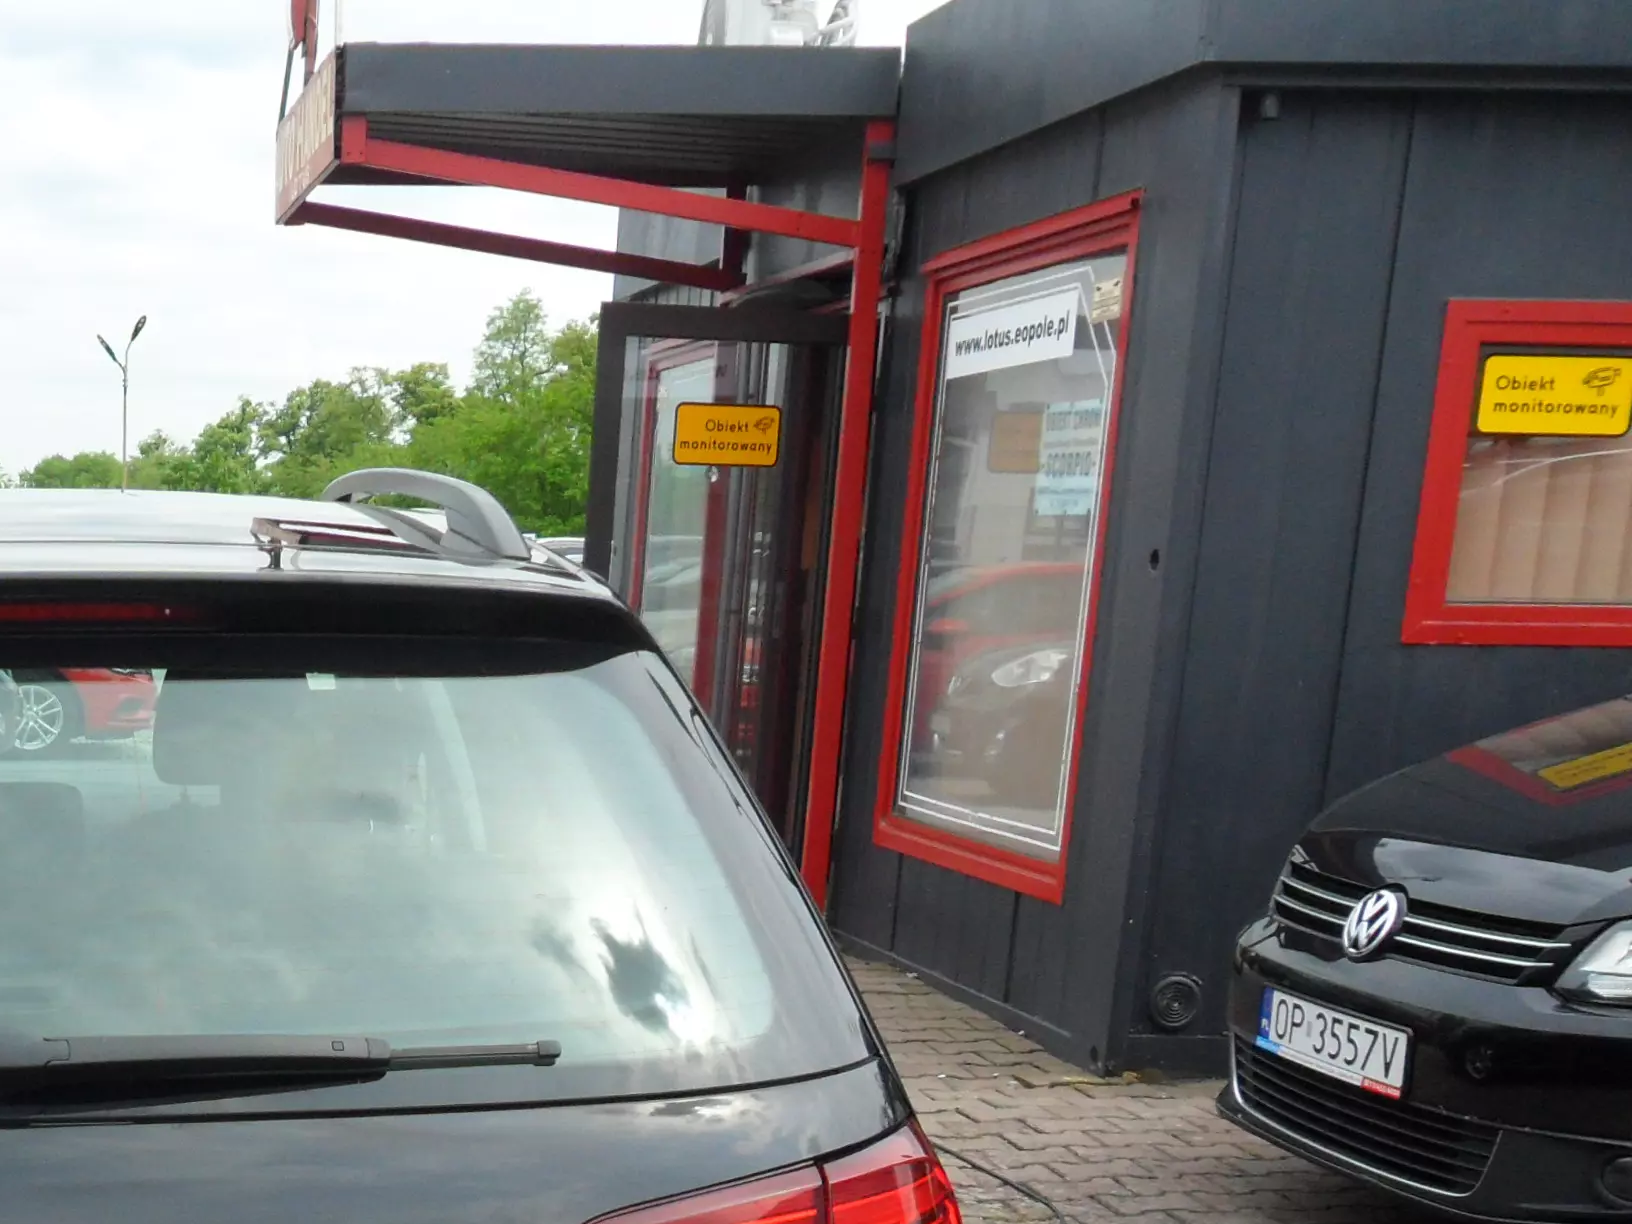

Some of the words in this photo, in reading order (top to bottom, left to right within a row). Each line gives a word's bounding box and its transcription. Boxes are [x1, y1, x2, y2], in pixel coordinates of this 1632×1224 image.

[955, 309, 1070, 356] www.lotus.eopole.pl
[1495, 374, 1556, 391] Obiekt
[1493, 399, 1619, 419] monitorowany
[705, 418, 749, 433] Obiekt
[679, 438, 773, 456] monitorowany
[1275, 999, 1305, 1044] OP
[1313, 1012, 1399, 1079] 3557V
